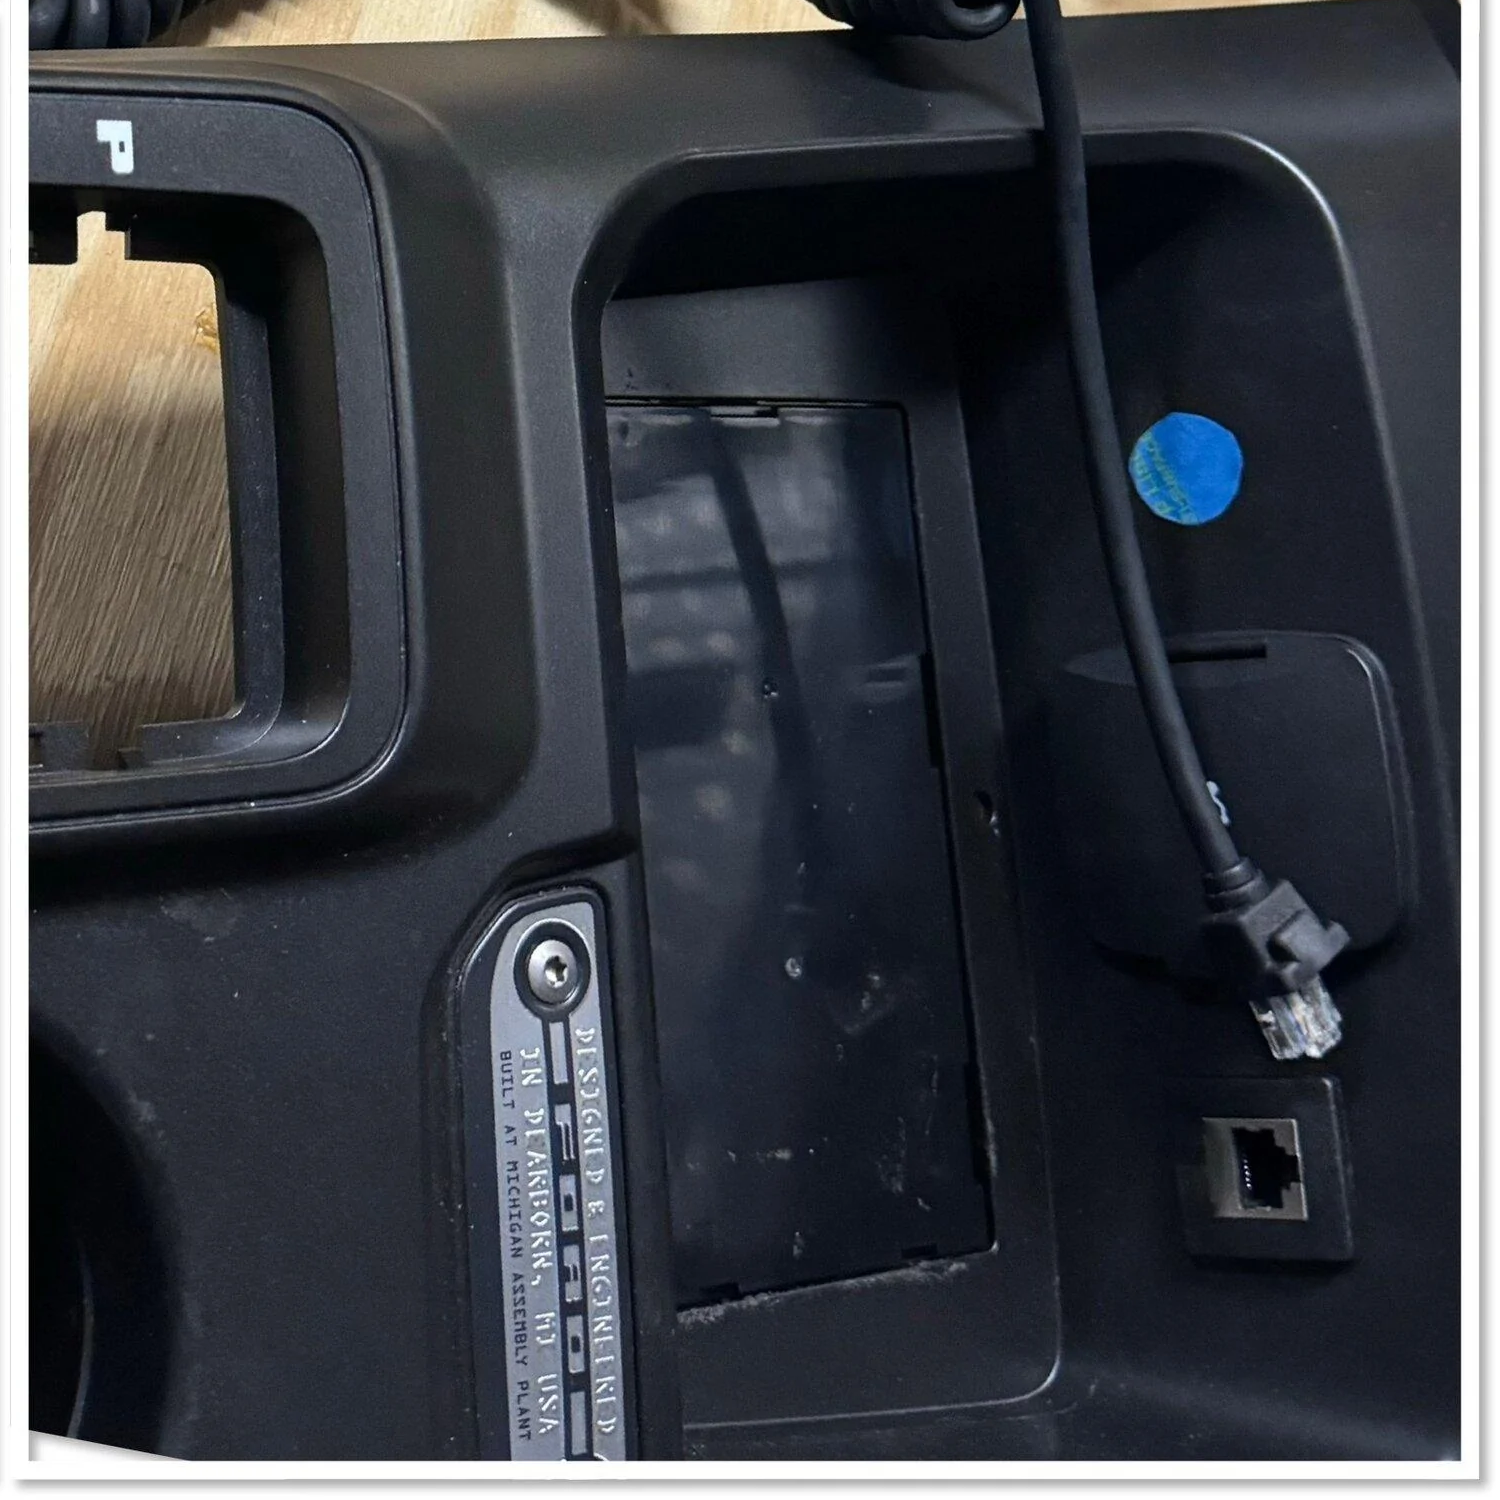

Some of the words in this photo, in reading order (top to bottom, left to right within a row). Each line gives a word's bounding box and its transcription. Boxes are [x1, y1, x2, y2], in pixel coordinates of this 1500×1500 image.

[97, 120, 135, 174] P
[499, 1049, 515, 1109] BUILT
[519, 1047, 543, 1089] IN
[504, 1123, 518, 1147] AT
[575, 1026, 605, 1186] DESIGNED
[506, 1157, 523, 1260] MICHIGAN
[522, 1107, 553, 1287] DEARBORN,
[552, 1102, 587, 1376] FORD
[511, 1269, 529, 1367] ASSEMBLY
[533, 1310, 557, 1347] MI
[588, 1233, 617, 1436] ENGINEERED
[515, 1377, 533, 1443] PLANT
[536, 1372, 561, 1437] USA
